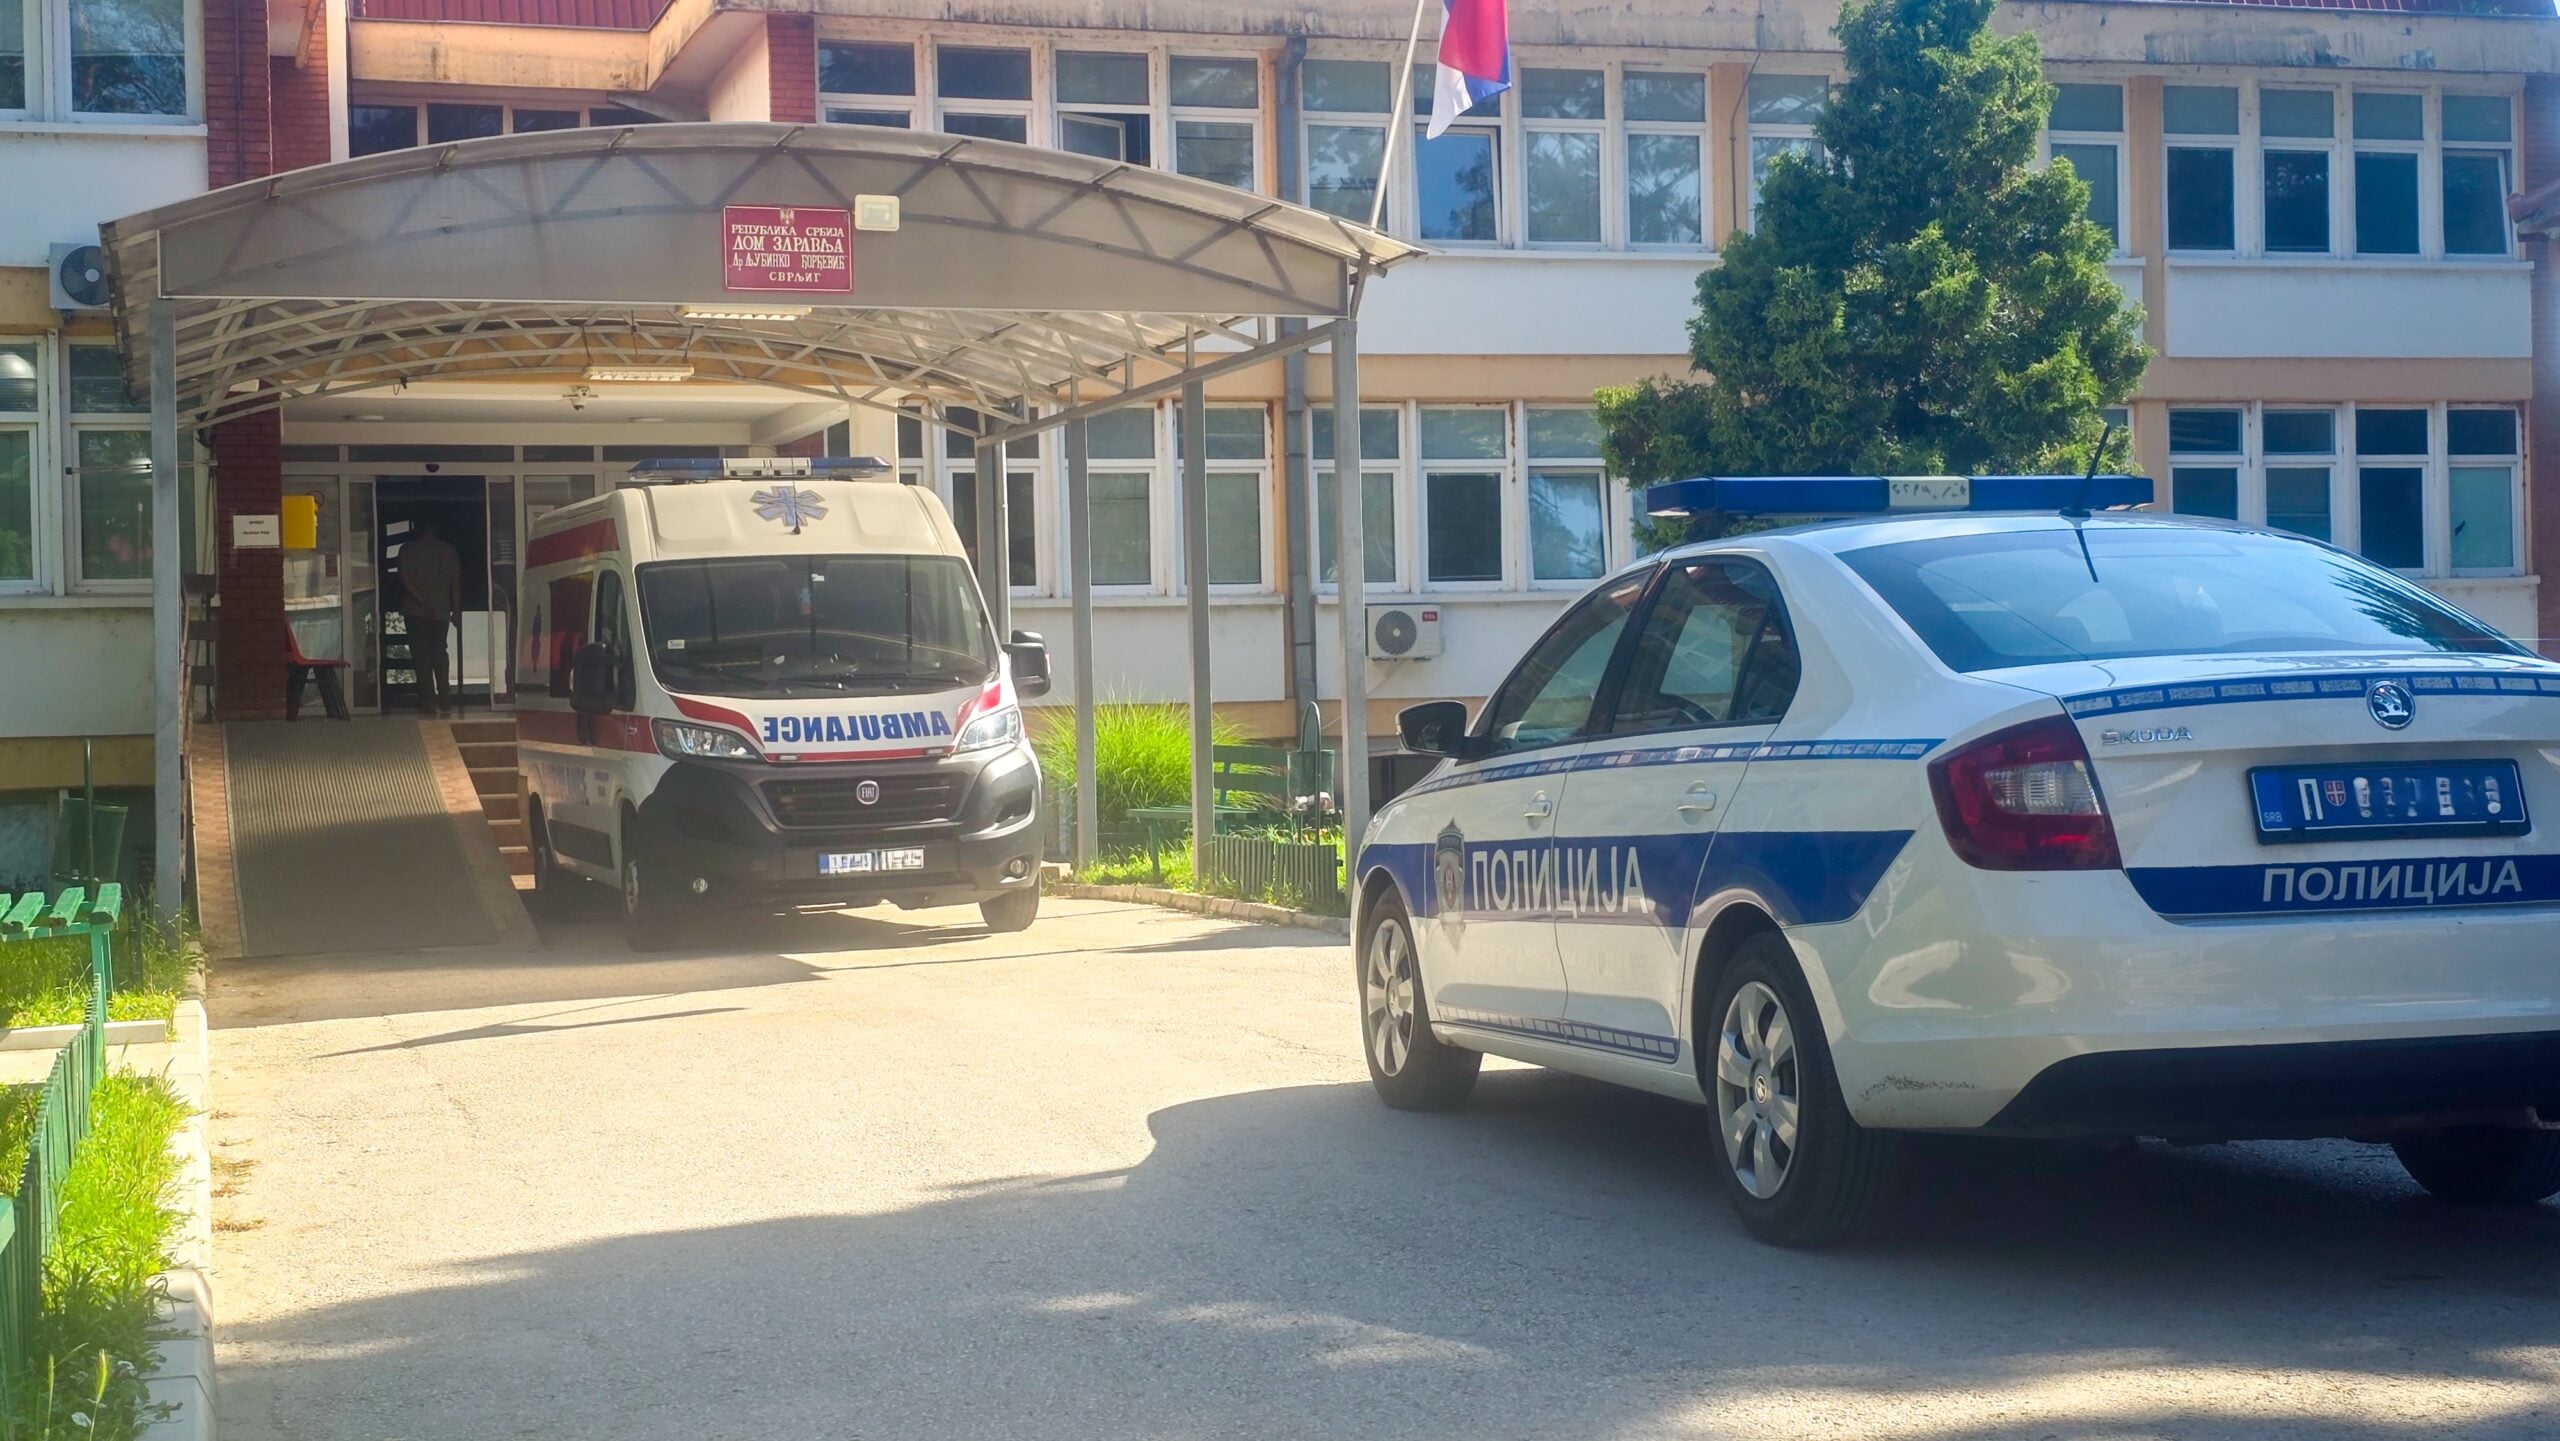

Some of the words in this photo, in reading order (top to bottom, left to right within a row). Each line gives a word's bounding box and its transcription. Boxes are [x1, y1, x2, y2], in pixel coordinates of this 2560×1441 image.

[731, 224, 797, 236] РЕПУБЛИКА
[805, 227, 844, 237] СРБИЈА
[733, 236, 765, 250] ДОМ
[773, 237, 844, 253] ЗДРАВЉА
[745, 253, 790, 267] ЉУБИНКО
[769, 271, 822, 283] СВРЉИГ
[861, 786, 875, 798] FIAT
[2264, 811, 2283, 823] SRB
[1472, 846, 1648, 919] ПОЛИЦИЈА
[2263, 861, 2522, 904] ПОЛИЦИЈА
